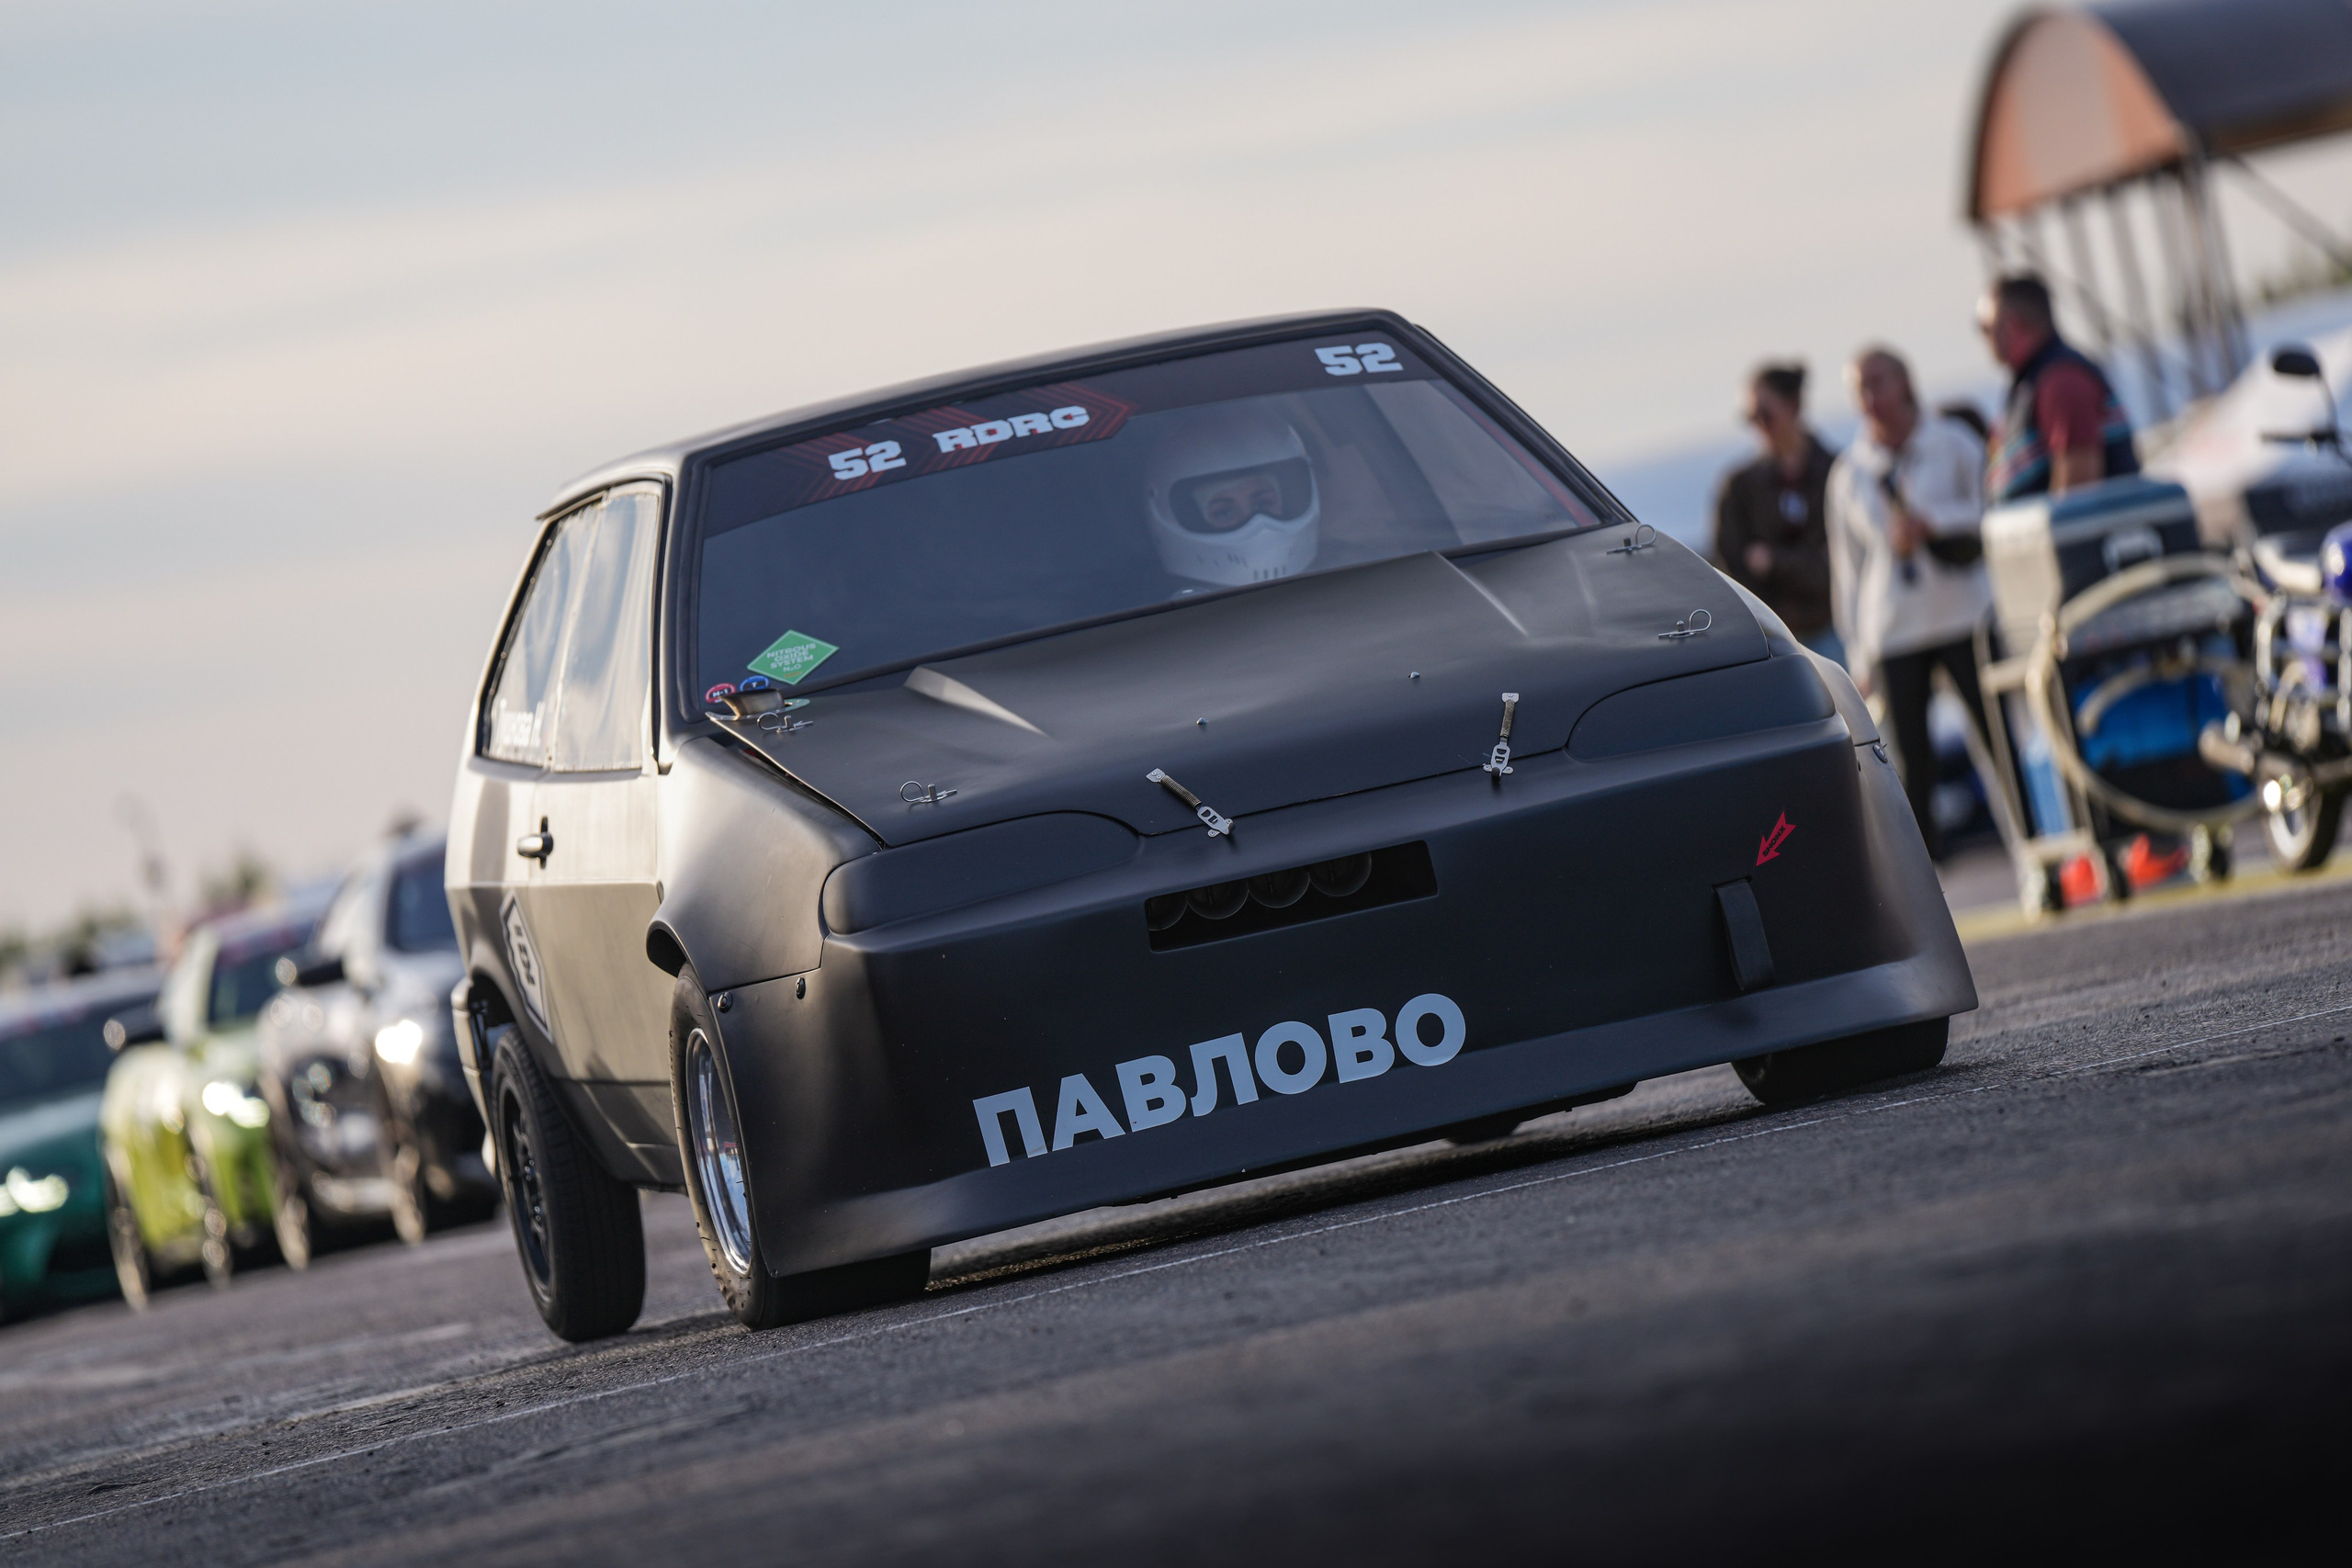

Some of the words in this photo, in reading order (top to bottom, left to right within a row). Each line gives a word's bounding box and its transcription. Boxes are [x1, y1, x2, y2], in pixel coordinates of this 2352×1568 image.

[1314, 342, 1404, 377] 52
[828, 440, 907, 480] 52
[933, 405, 1091, 454] RDRC
[767, 643, 816, 659] NITROUS
[770, 654, 814, 669] SYSTEM
[774, 650, 808, 662] OXIDE
[1762, 825, 1786, 857] SHONX
[972, 992, 1467, 1168] ПАВЛОВО
